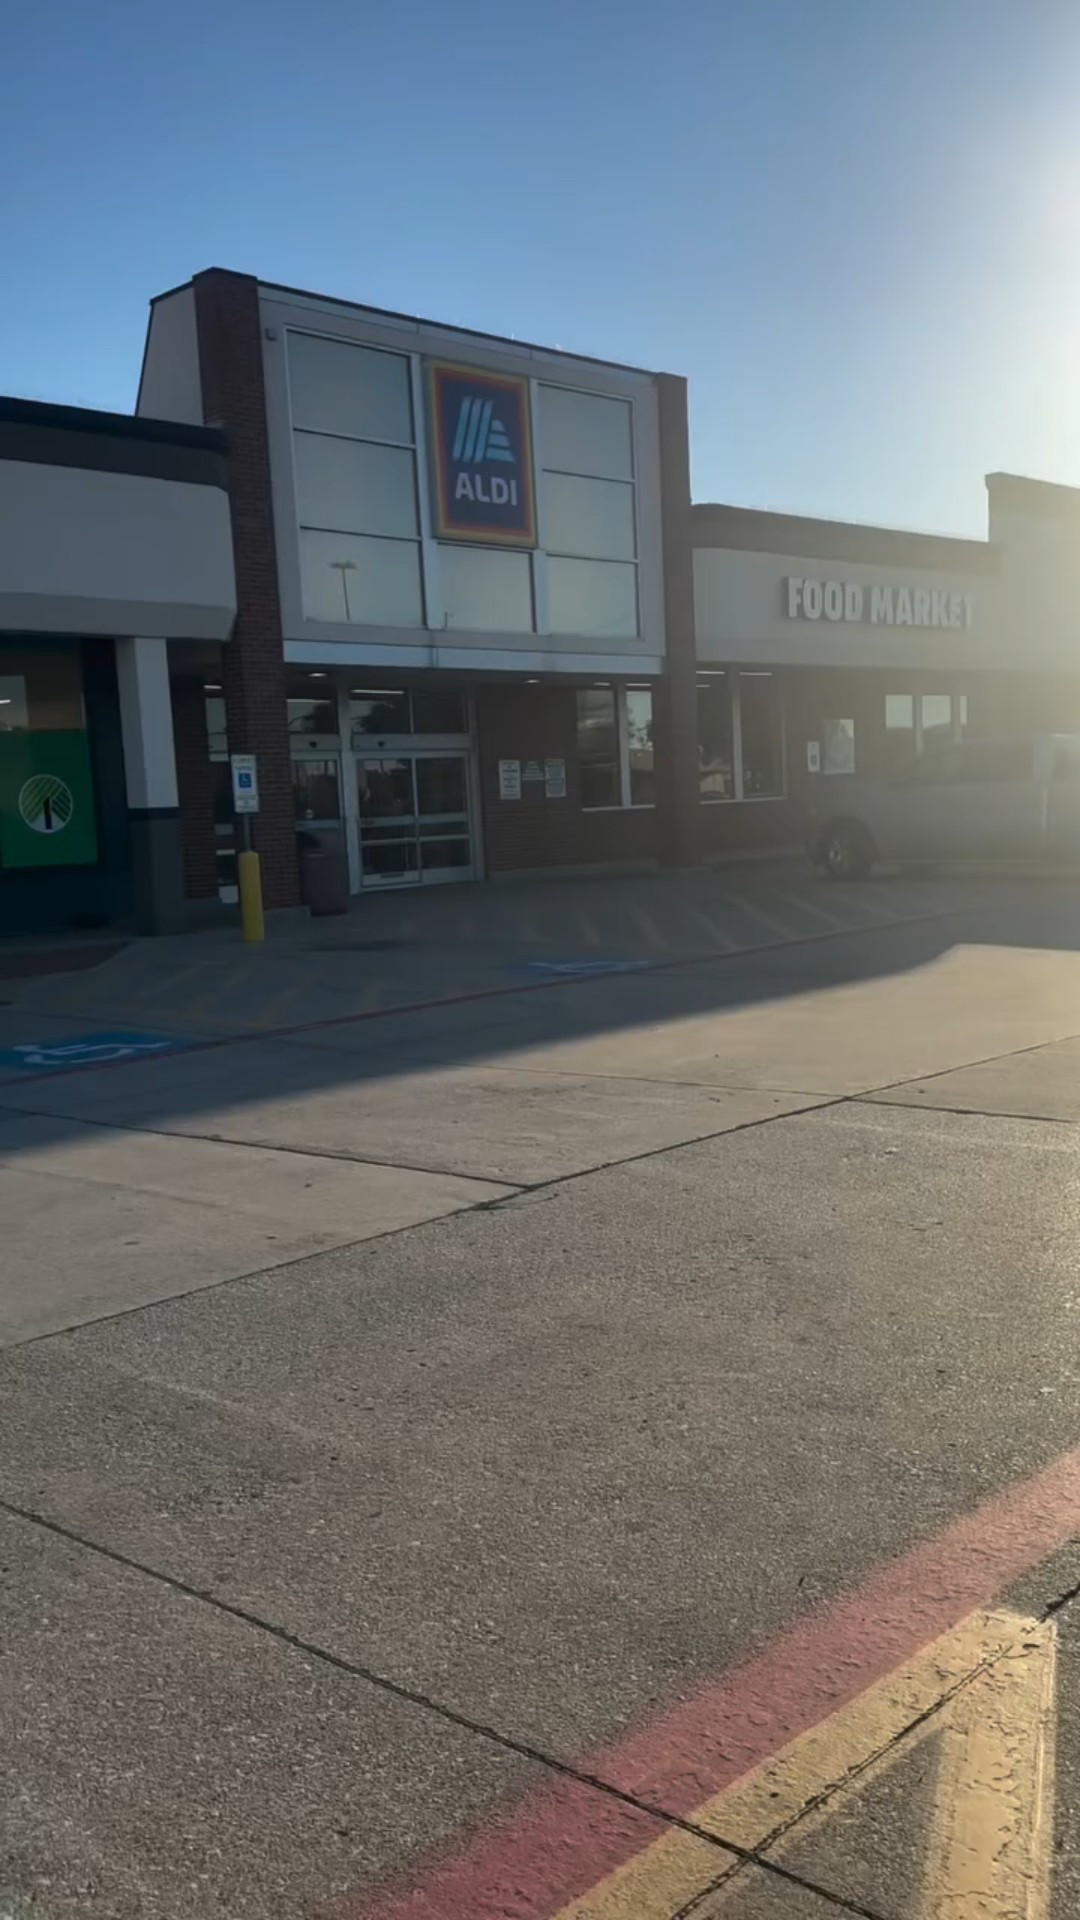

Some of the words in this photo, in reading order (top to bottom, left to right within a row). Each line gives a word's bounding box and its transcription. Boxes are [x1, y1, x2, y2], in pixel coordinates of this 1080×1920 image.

[455, 472, 517, 506] ALDI
[787, 575, 864, 621] FOOD
[870, 586, 974, 631] MARKET
